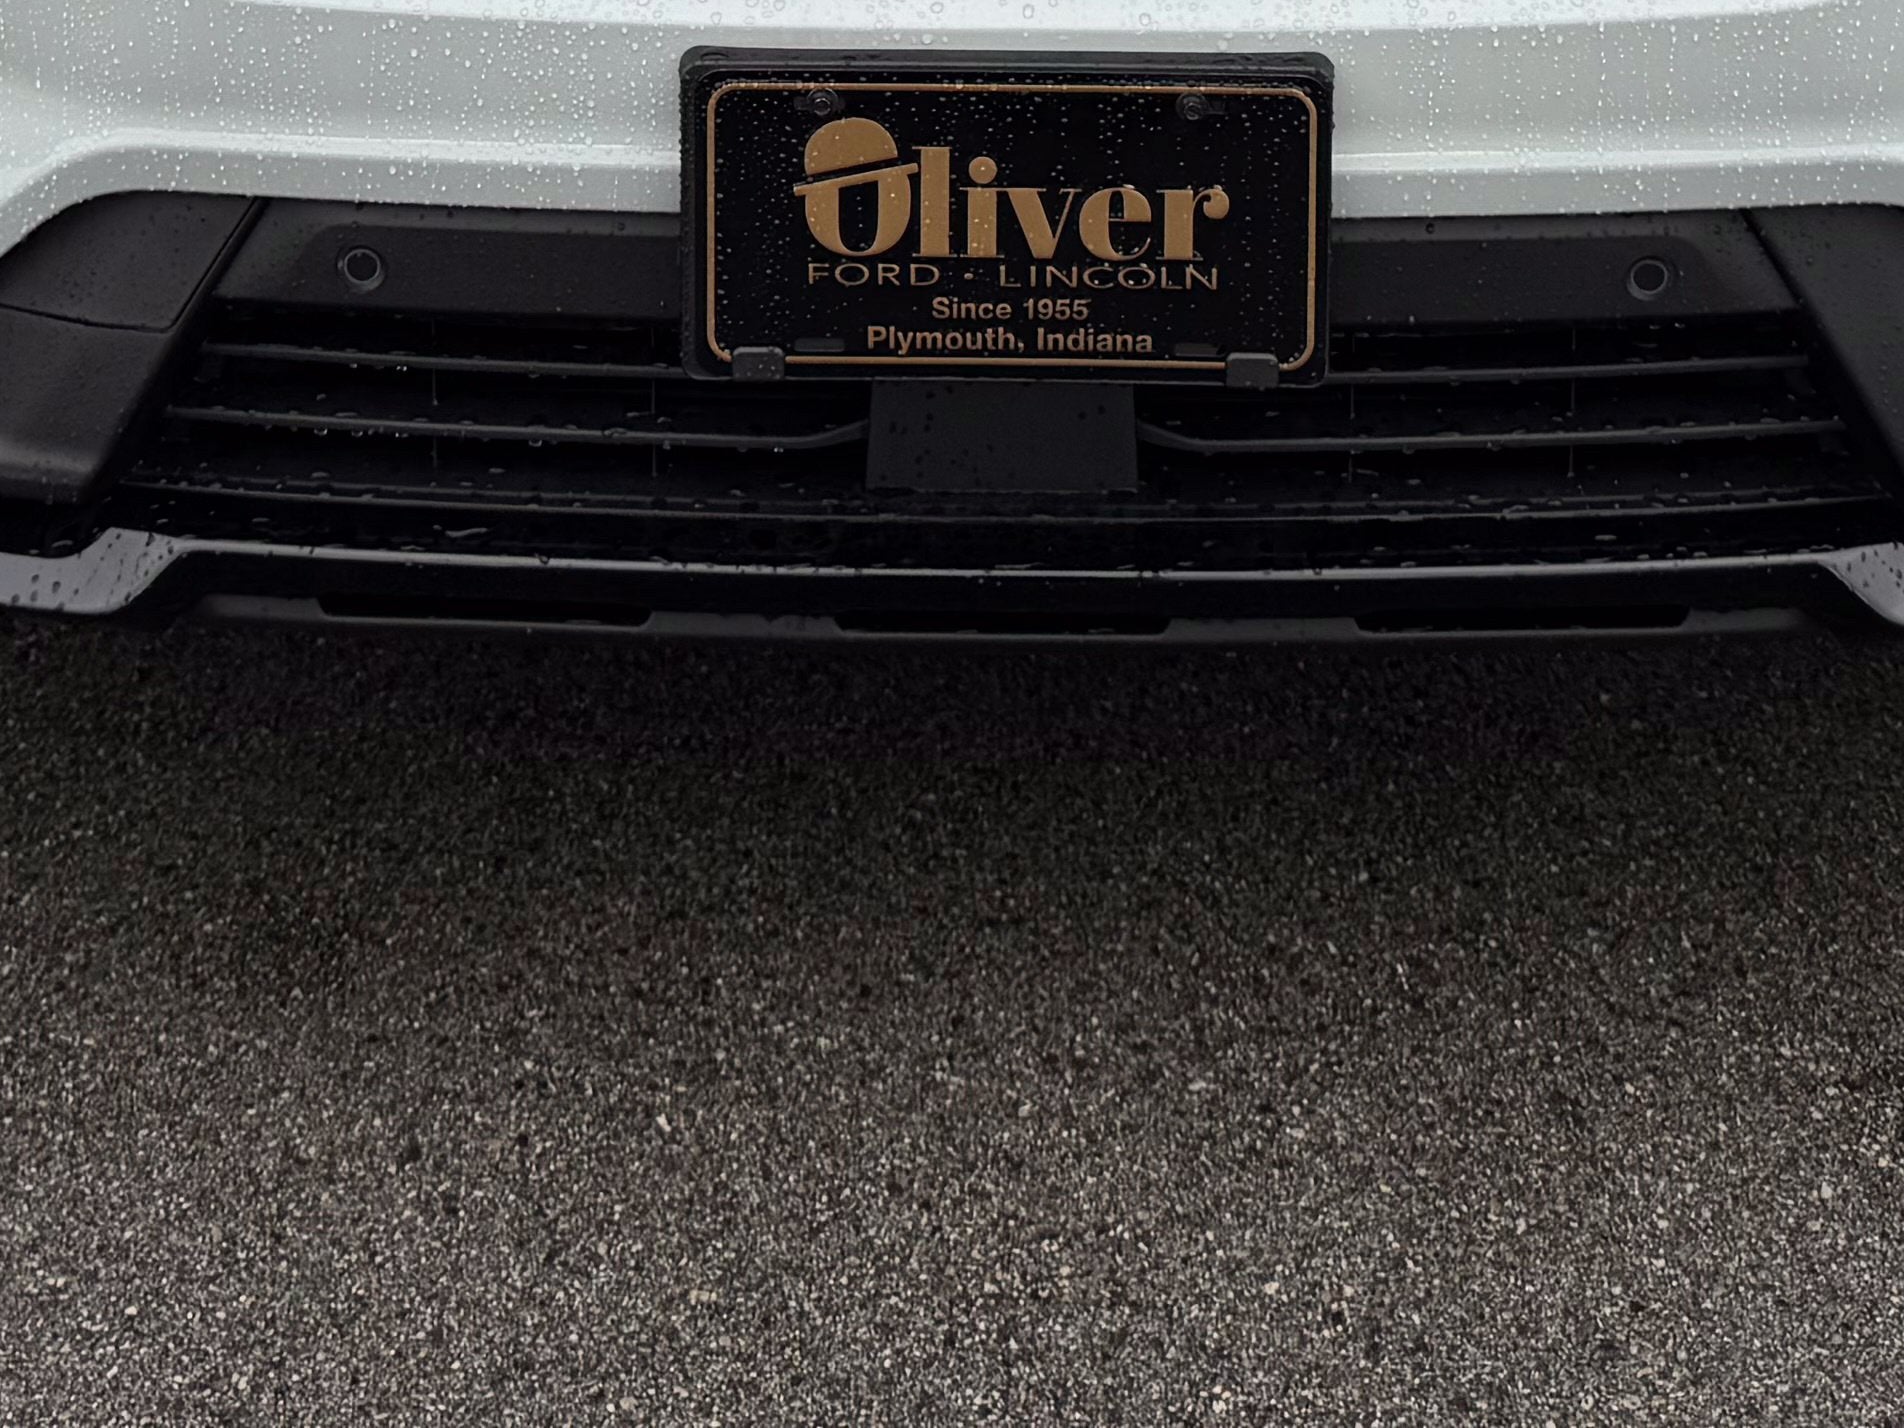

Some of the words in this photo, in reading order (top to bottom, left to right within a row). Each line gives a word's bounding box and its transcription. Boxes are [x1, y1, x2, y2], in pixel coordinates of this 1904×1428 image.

[793, 116, 1231, 261] Oliver
[807, 262, 941, 287] FORD
[997, 264, 1219, 291] LINCOLN
[931, 297, 1012, 320] Since
[1026, 298, 1090, 321] 1955
[866, 325, 1025, 355] Plymouth,
[1036, 327, 1154, 354] Indiana
